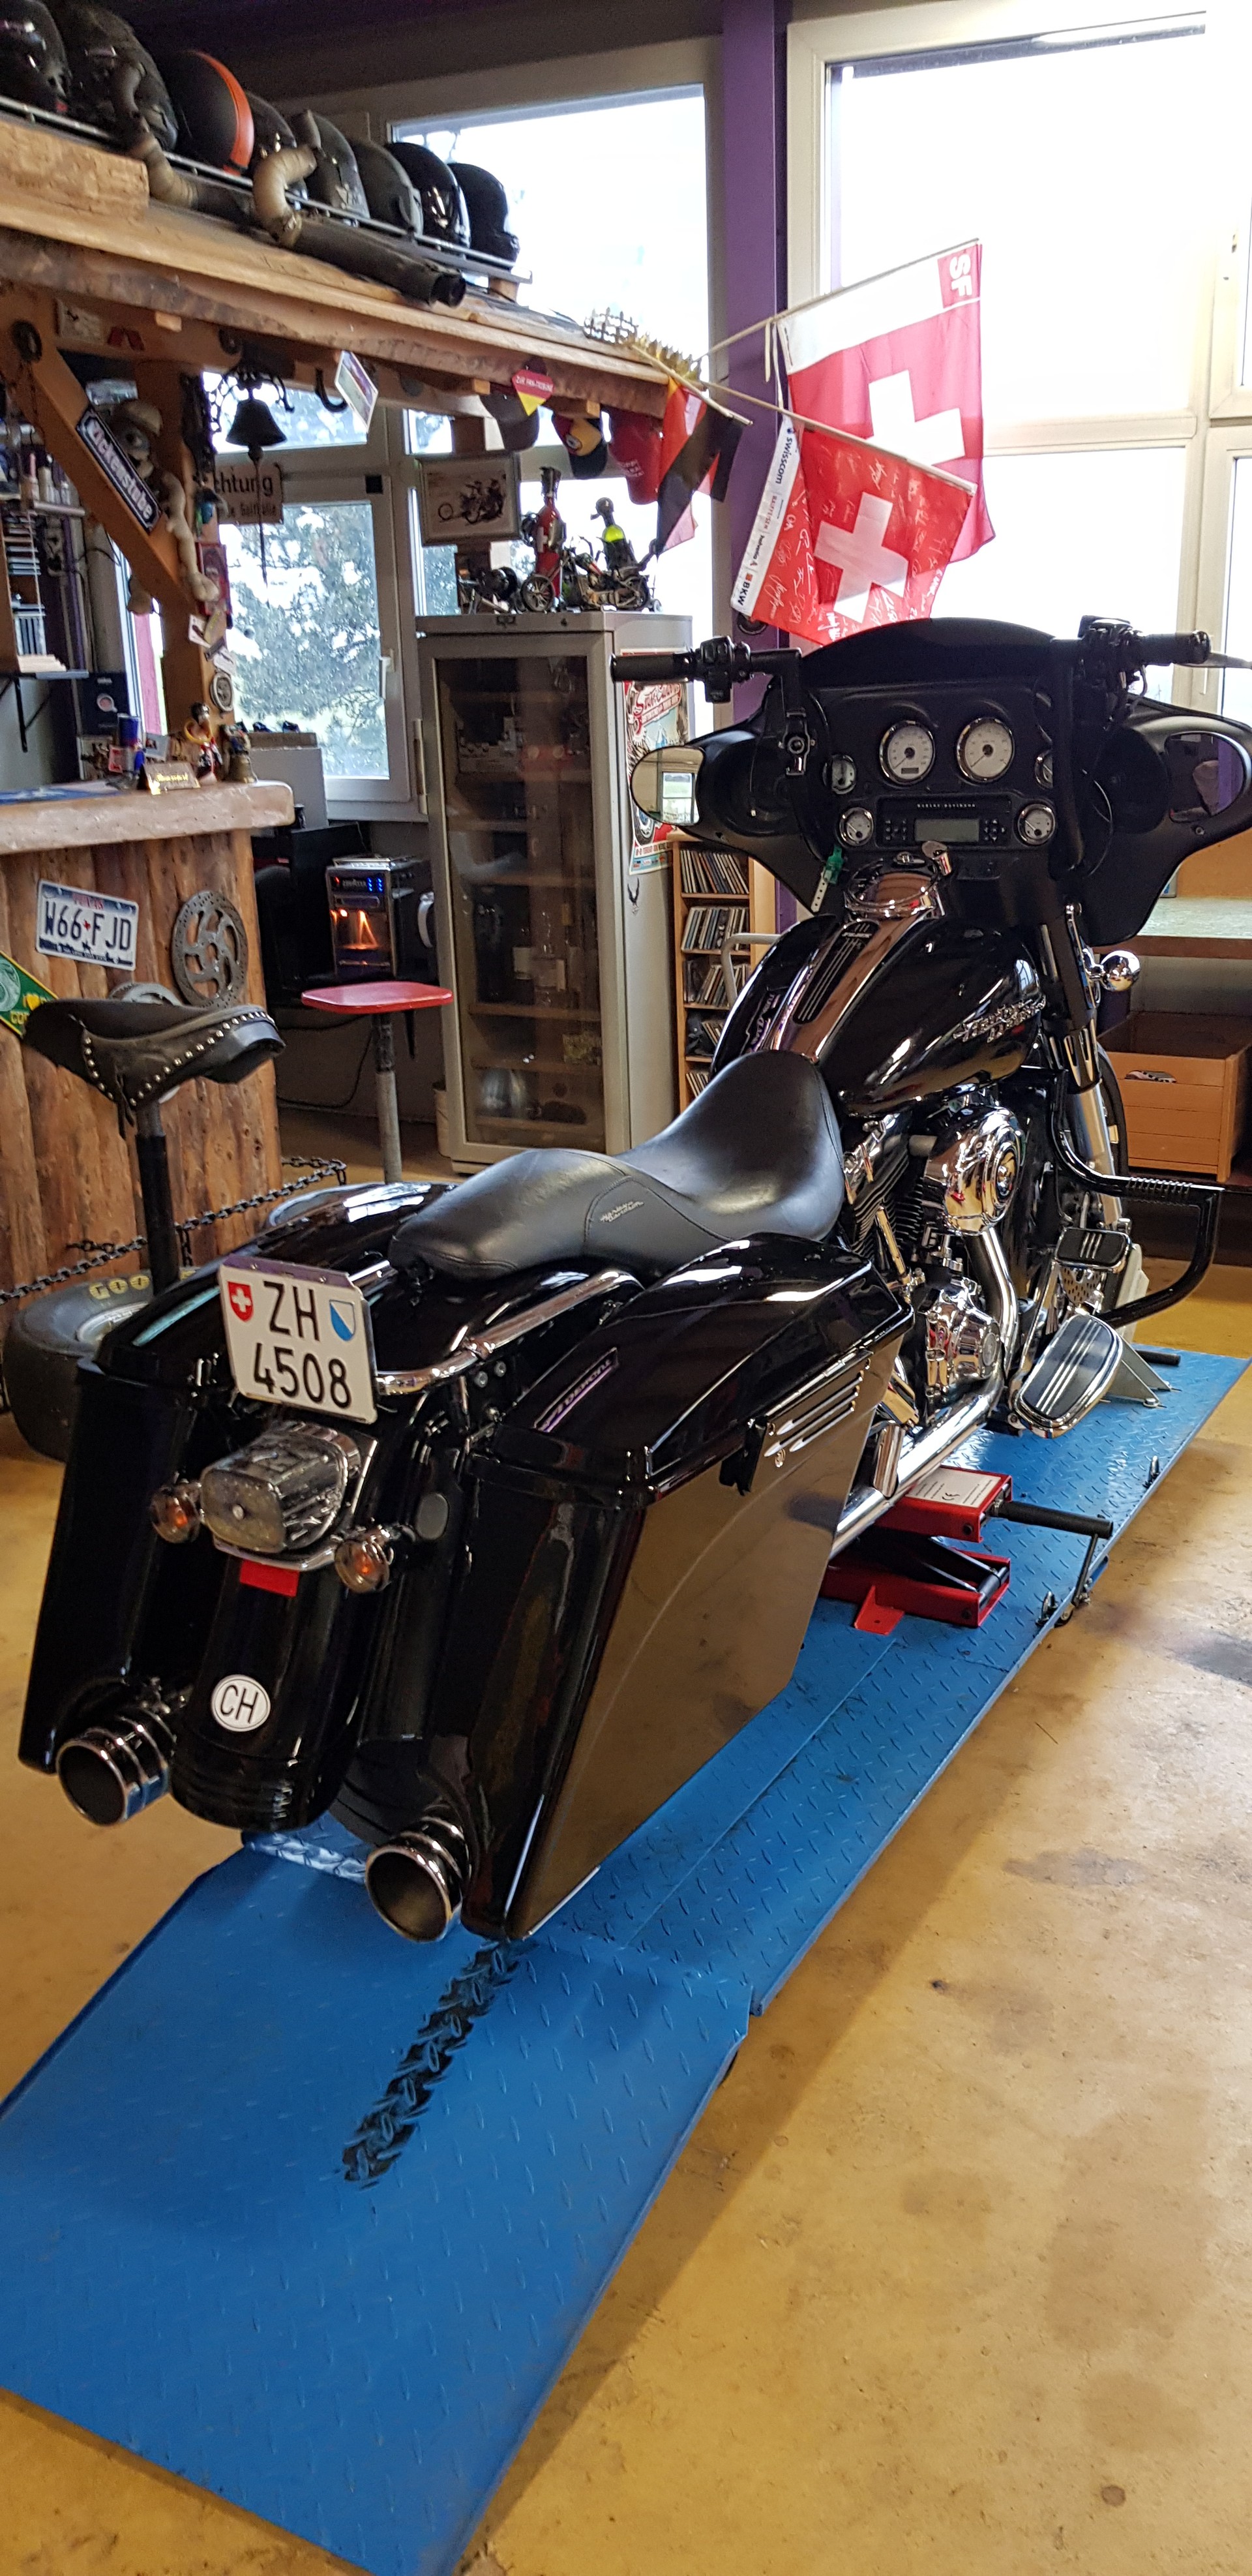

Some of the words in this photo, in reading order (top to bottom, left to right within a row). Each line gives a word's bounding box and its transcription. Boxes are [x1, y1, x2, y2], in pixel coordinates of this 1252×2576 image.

[949, 254, 973, 297] SF
[775, 437, 793, 485] swisscom
[753, 535, 766, 562] helvetia
[737, 581, 751, 607] BKW
[263, 1280, 320, 1342] ZH
[254, 1342, 352, 1409] 4508
[220, 1684, 259, 1724] CH
